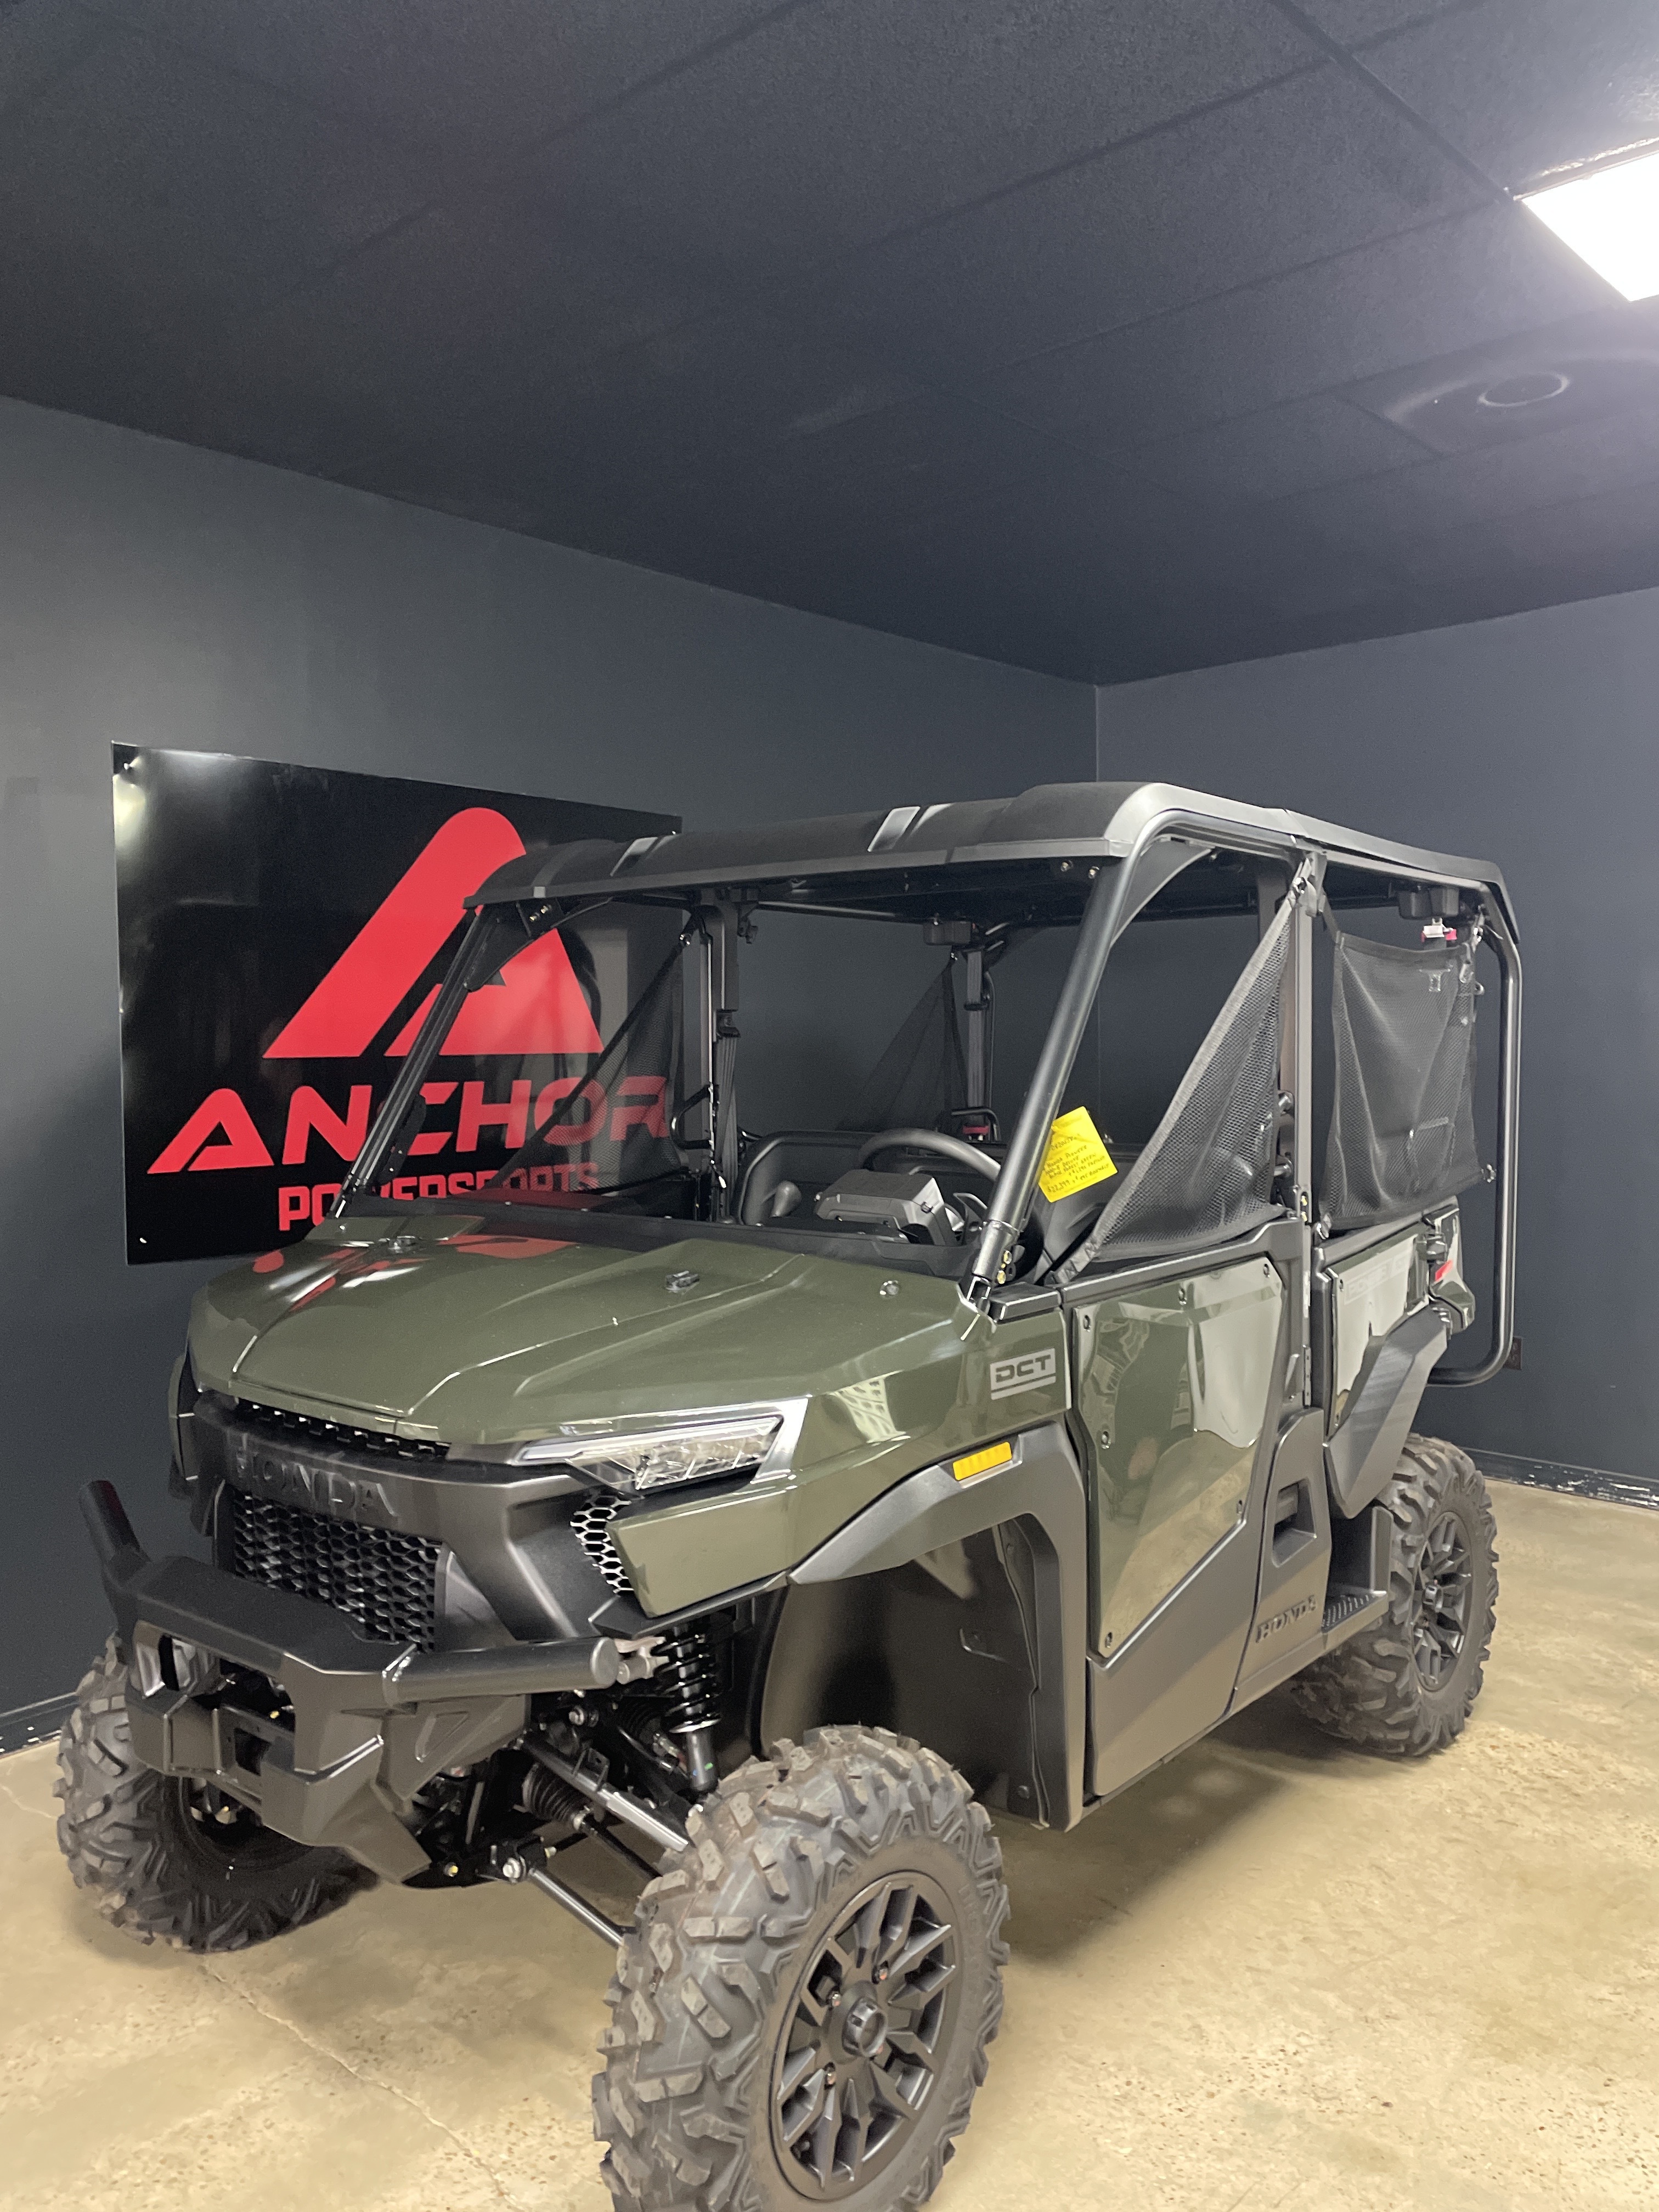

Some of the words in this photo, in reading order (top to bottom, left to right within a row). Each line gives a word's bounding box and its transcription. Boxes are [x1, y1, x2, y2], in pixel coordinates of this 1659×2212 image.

[278, 1162, 600, 1231] POERSORTS
[995, 1354, 1051, 1383] DCT
[234, 1445, 398, 1519] HONDA
[1255, 1594, 1316, 1643] HONDA
